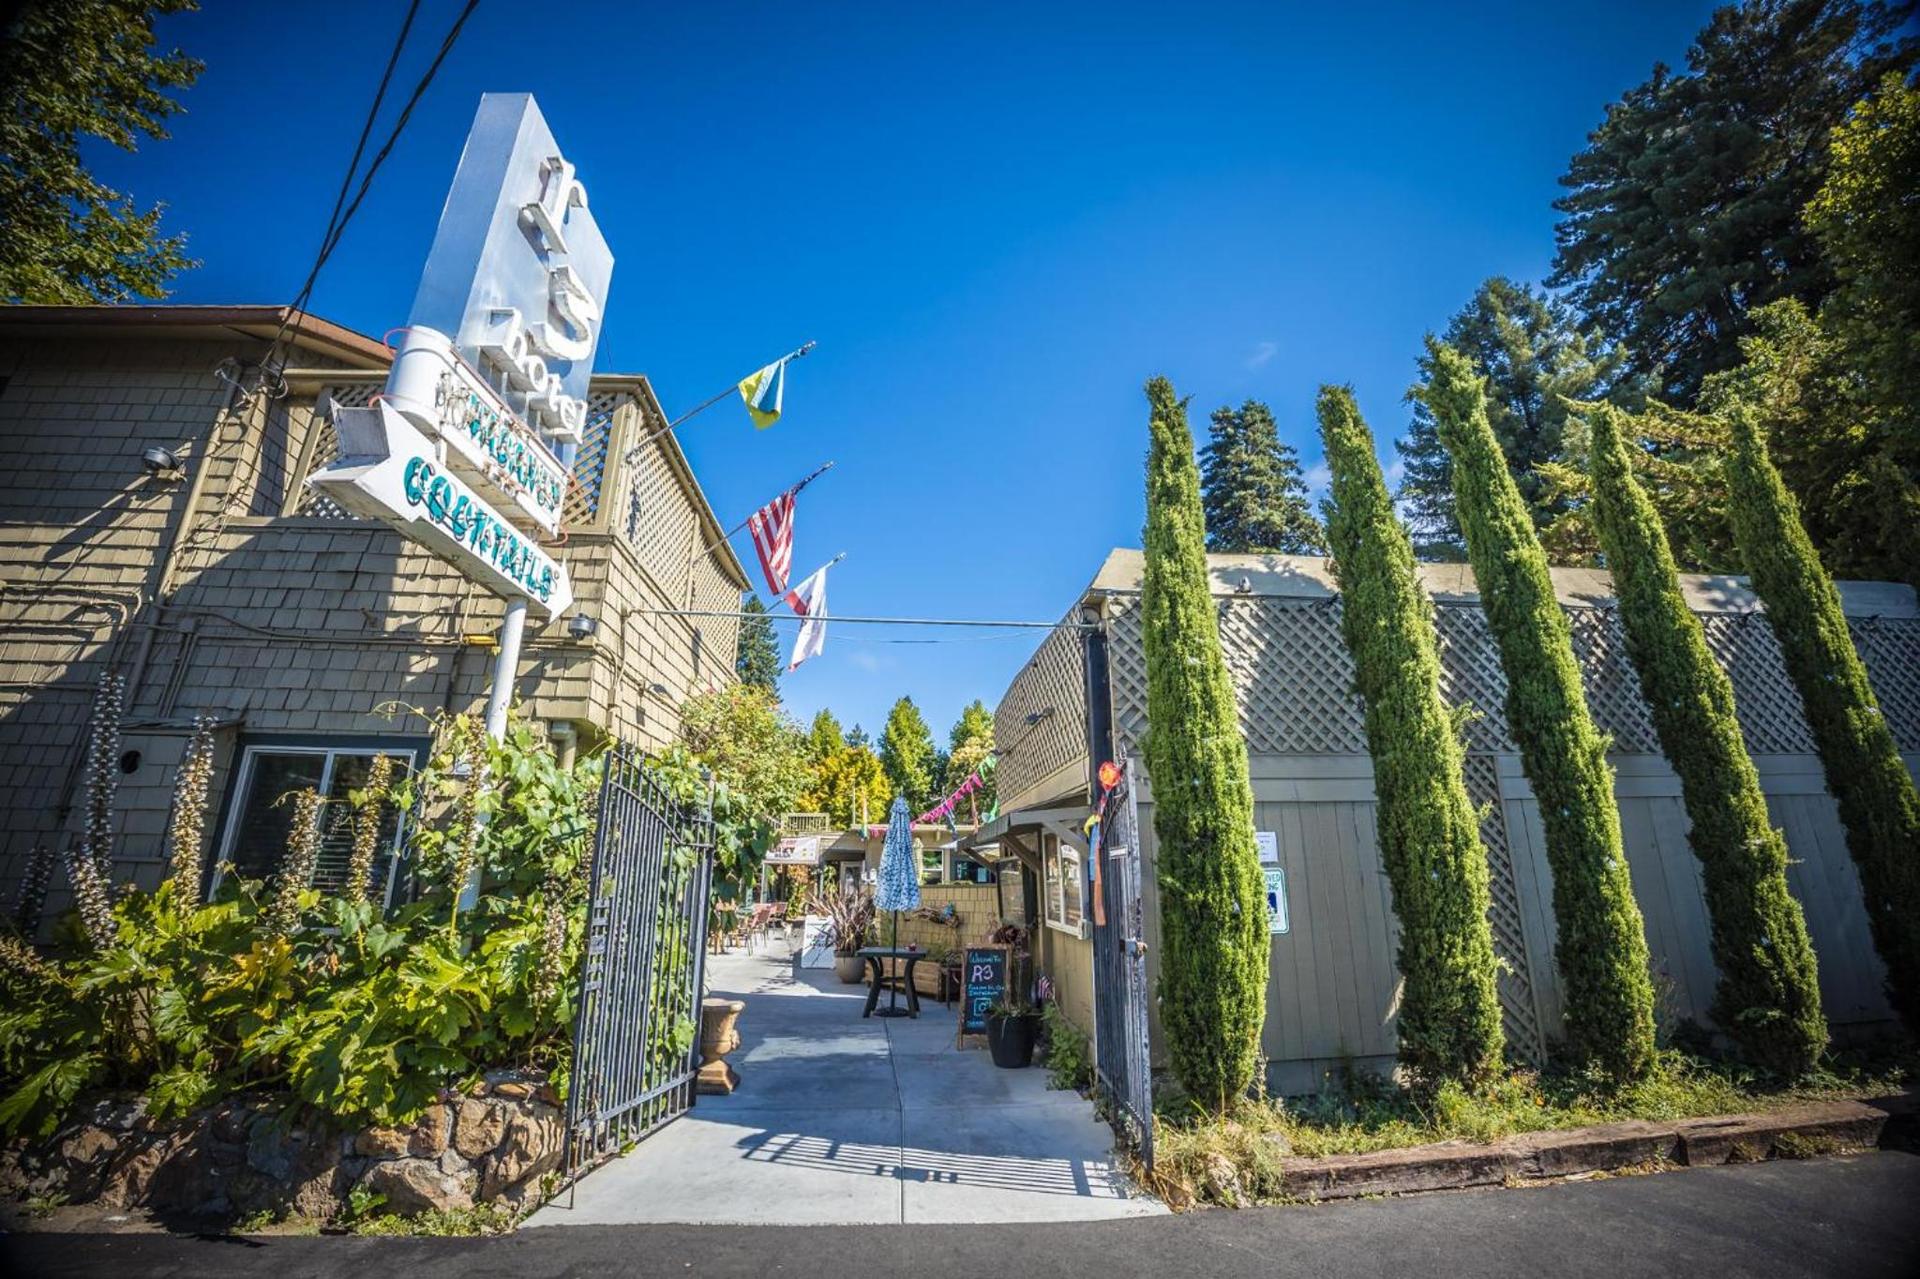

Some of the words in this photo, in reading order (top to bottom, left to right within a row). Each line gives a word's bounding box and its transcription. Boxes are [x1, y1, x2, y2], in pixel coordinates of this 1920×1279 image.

[492, 307, 588, 445] hotel
[404, 456, 560, 603] COCKTAILS
[971, 964, 994, 983] R3
